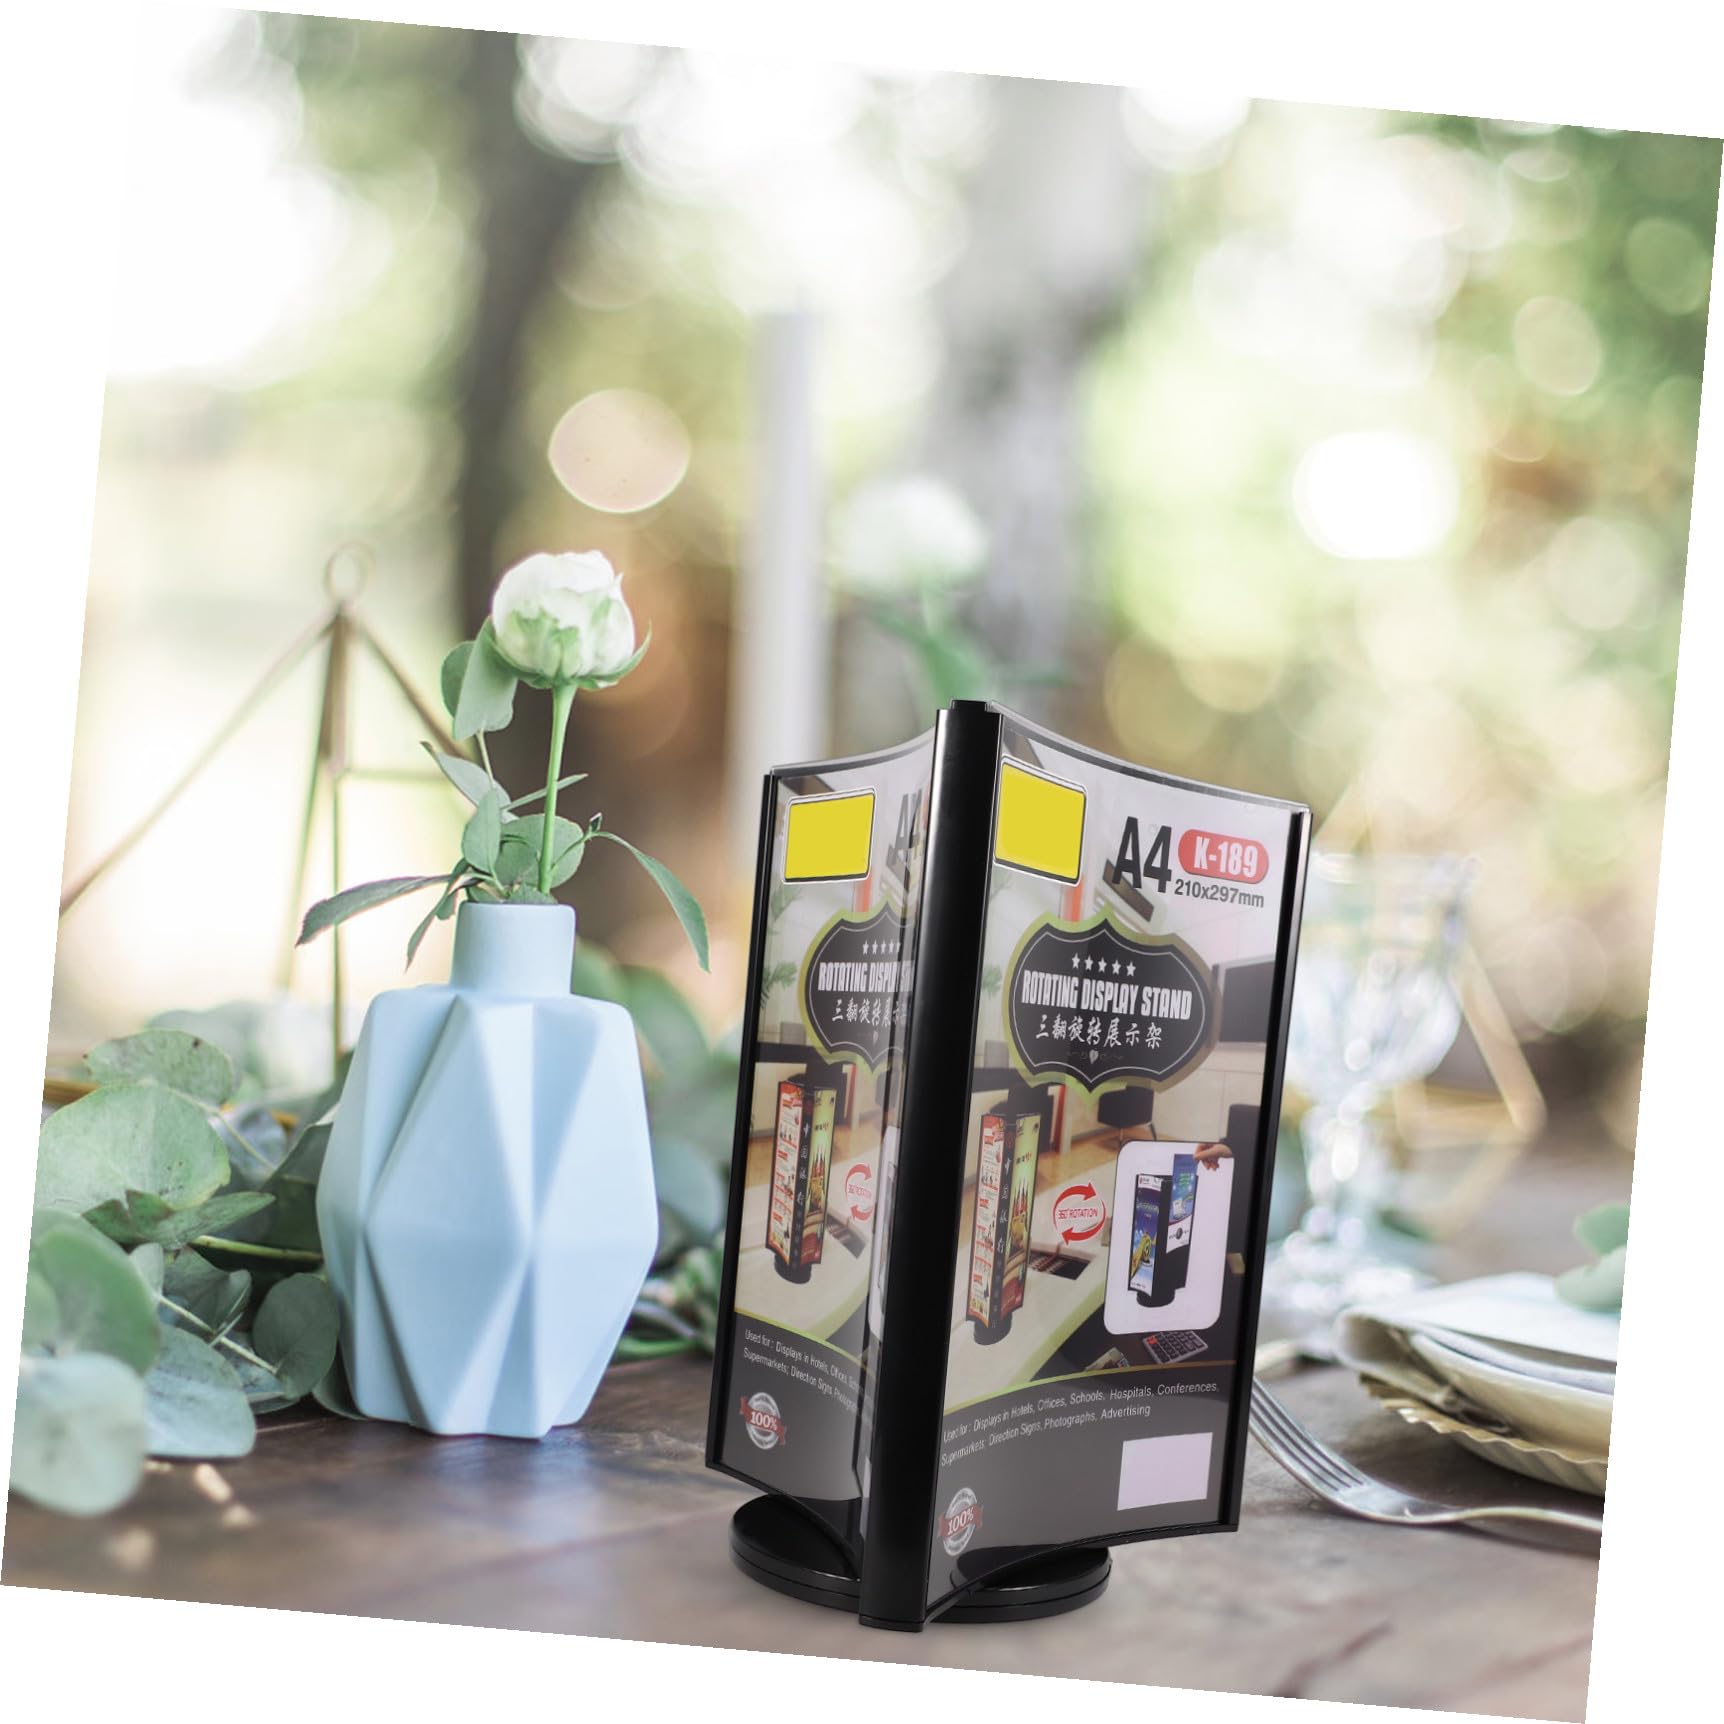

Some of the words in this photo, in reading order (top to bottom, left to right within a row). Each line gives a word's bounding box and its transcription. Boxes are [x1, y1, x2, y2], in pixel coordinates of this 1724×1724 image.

[1112, 816, 1172, 893] A4
[1194, 836, 1258, 878] K-189
[1174, 879, 1264, 908] 210x297mm
[818, 962, 868, 992] ROTATING
[1022, 969, 1080, 1009] ROTATING
[1080, 978, 1139, 1016] DISPLAY
[1141, 985, 1193, 1020] STAND
[1035, 1013, 1163, 1049] 三翻旋转展示架
[745, 1329, 760, 1344] Used
[776, 1341, 802, 1361] Displays
[791, 1365, 817, 1386] Direction
[750, 1411, 778, 1431] 100%
[973, 1412, 1002, 1432] Displays
[1002, 1411, 1010, 1421] in
[1037, 1398, 1067, 1411] Offices,
[1110, 1385, 1154, 1401] Hospitals,
[988, 1427, 1019, 1446] Direction
[1100, 1405, 1151, 1420] Advertising
[947, 1507, 974, 1536] 100%
